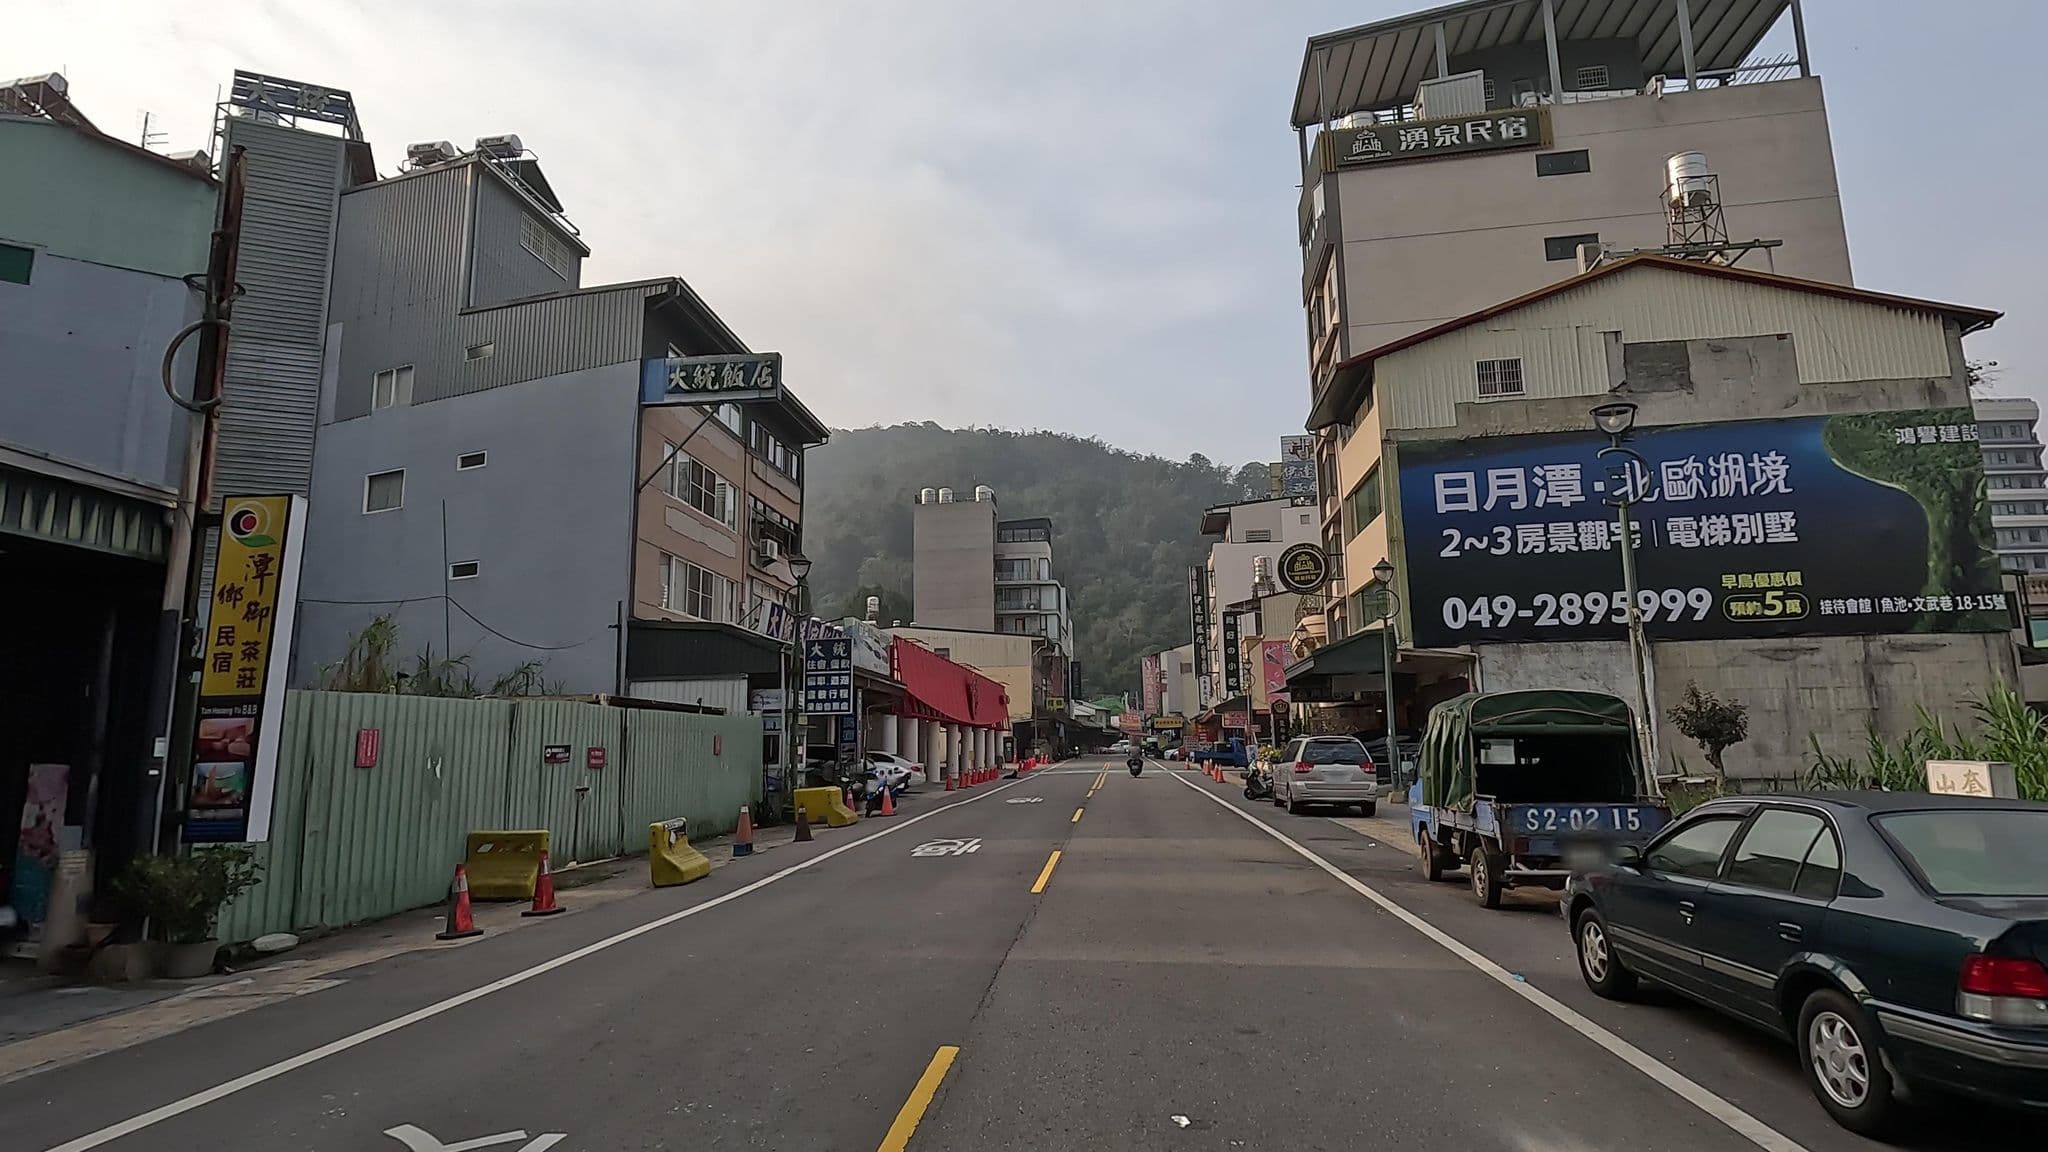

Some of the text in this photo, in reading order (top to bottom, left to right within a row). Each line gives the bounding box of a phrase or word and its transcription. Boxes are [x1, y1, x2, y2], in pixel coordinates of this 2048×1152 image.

[1398, 116, 1528, 151] 湧泉民宿
[669, 361, 773, 390] 大統飯店
[1895, 424, 1979, 444] 鴻譽建設
[1666, 511, 1798, 548] 電梯別墅
[1443, 588, 1711, 630] 049-2895999
